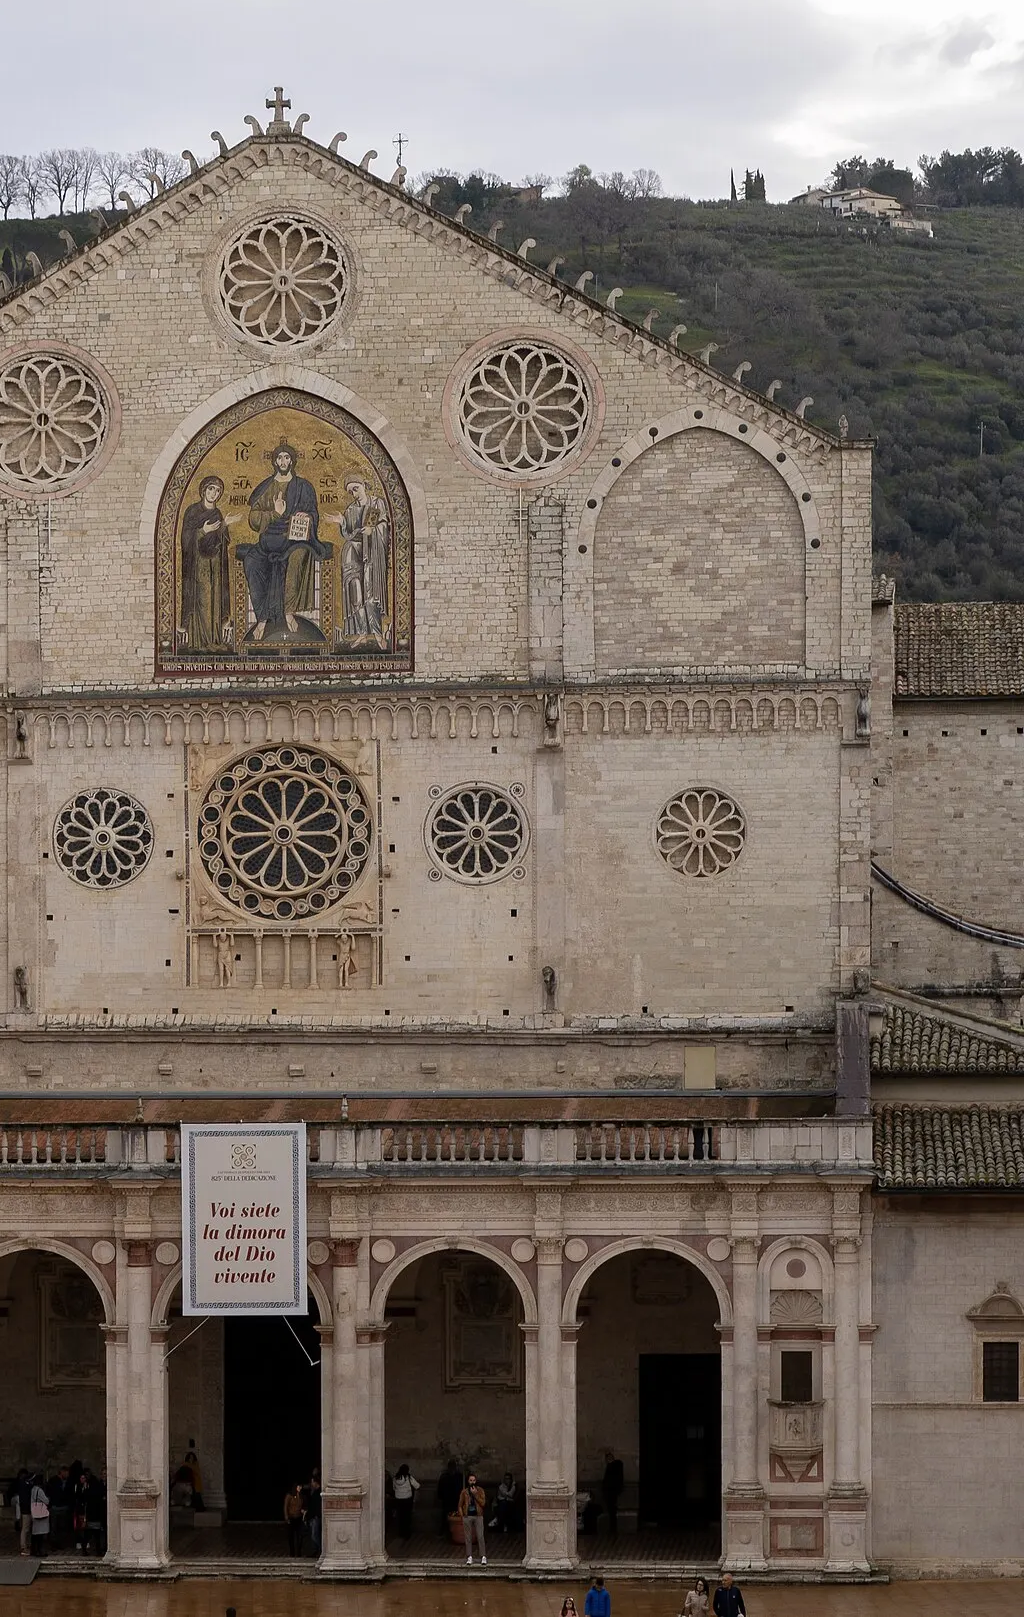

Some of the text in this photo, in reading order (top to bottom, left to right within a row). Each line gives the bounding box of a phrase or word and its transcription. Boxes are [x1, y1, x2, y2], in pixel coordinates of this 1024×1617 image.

[211, 1202, 280, 1218] Voi siete
[203, 1224, 286, 1240] la dimora
[214, 1246, 276, 1261] del Dio
[214, 1268, 276, 1283] vivente
